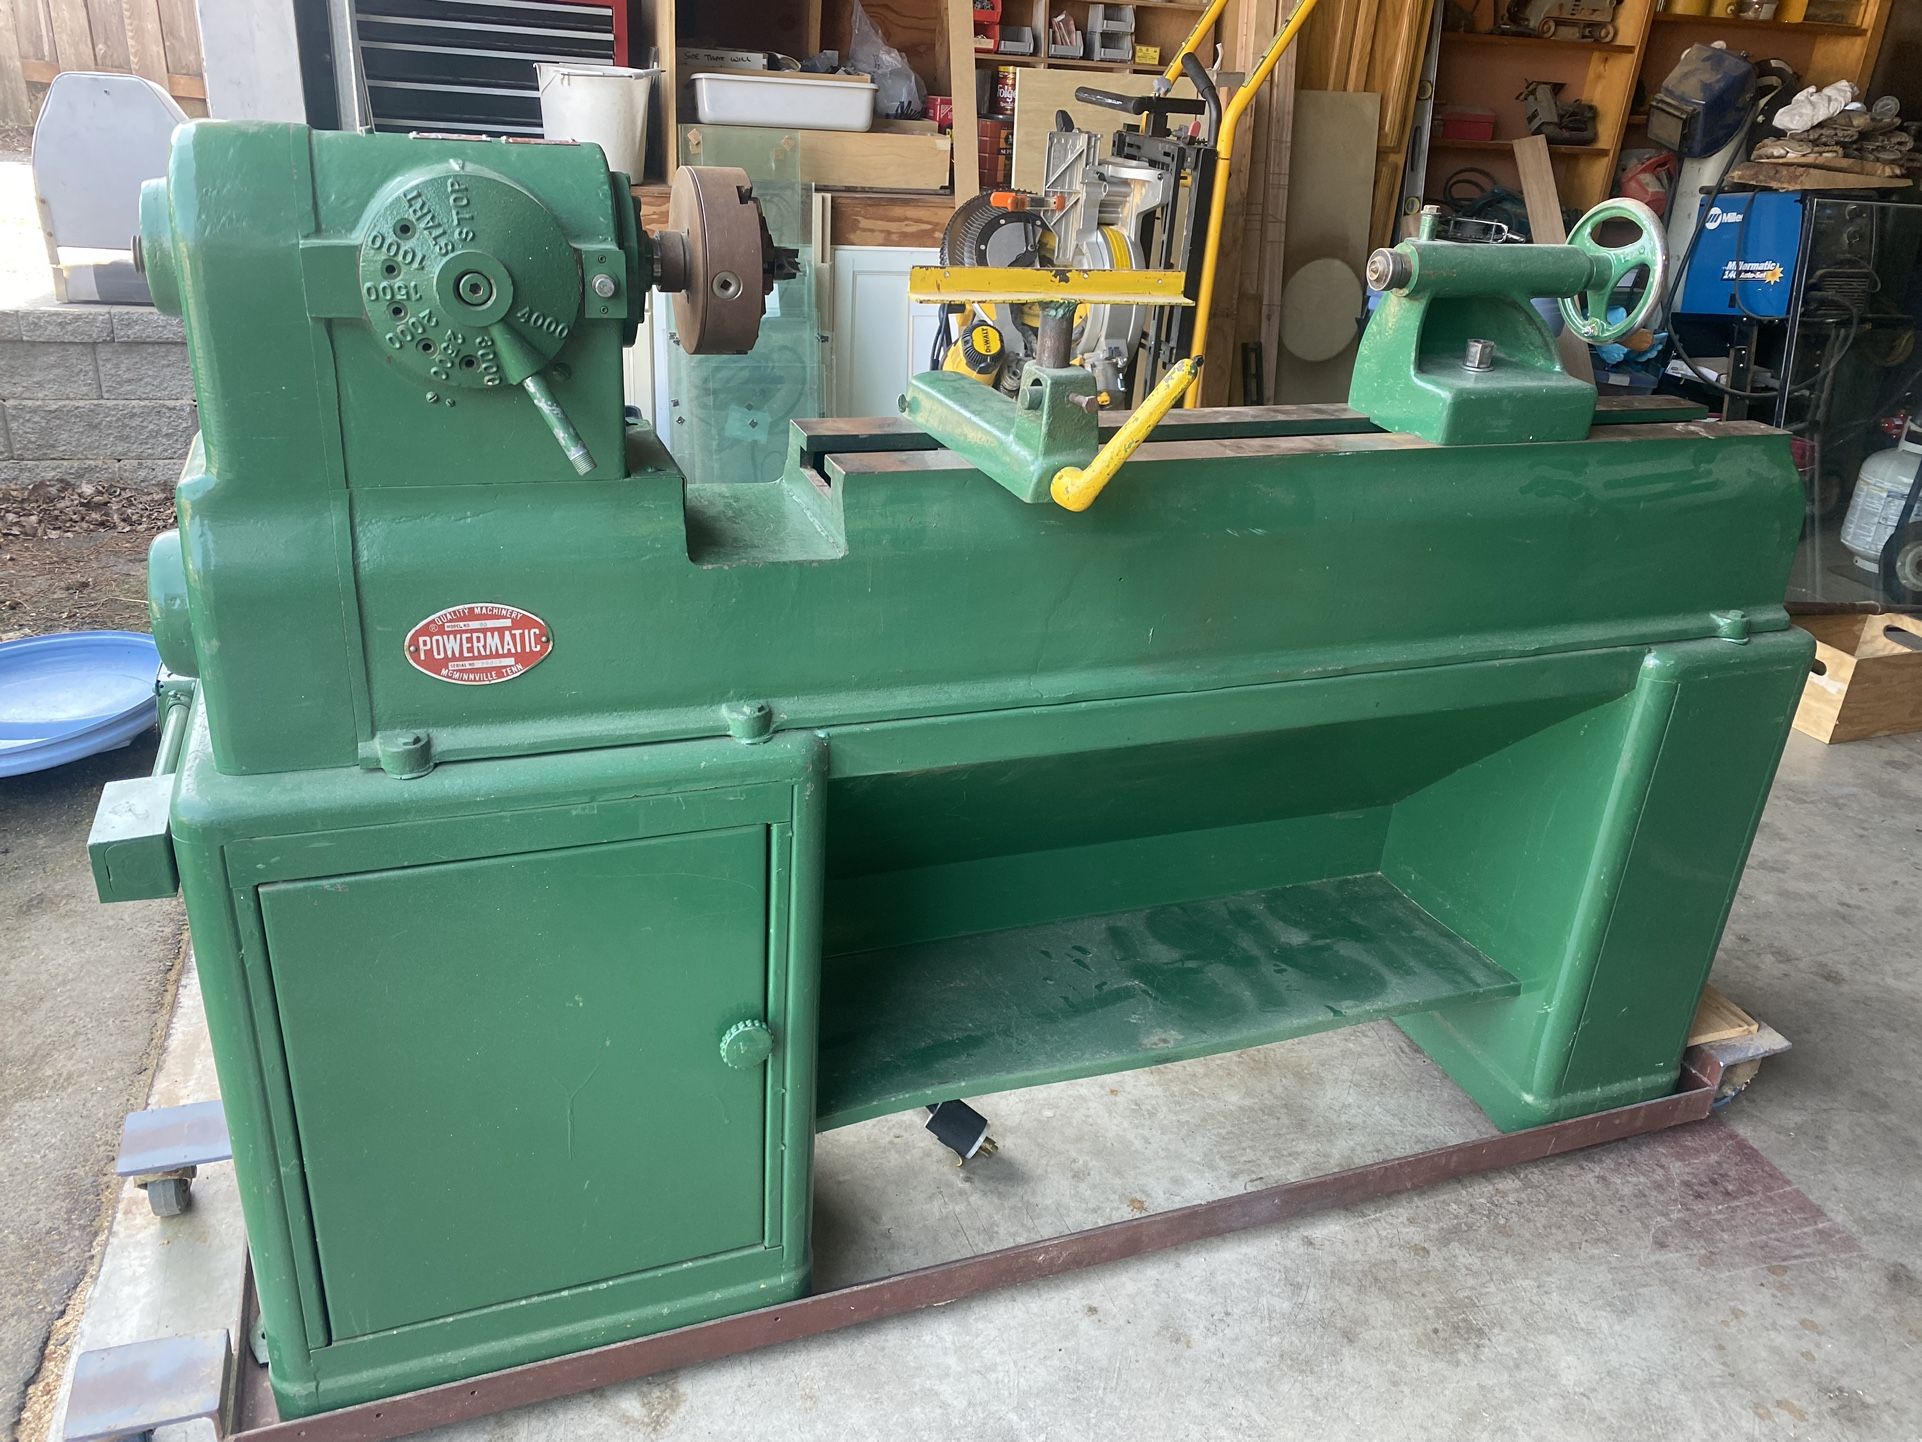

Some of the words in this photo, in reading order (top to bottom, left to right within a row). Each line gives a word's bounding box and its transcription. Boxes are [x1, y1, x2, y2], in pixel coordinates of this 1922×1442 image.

[401, 190, 455, 257] START
[447, 178, 475, 242] STOP
[369, 231, 426, 271] 1000
[364, 281, 423, 301] 1500
[385, 308, 438, 349] 2000
[516, 305, 569, 339] 4000
[430, 329, 464, 380] 2500
[475, 336, 501, 386] 3000
[434, 608, 469, 625] QUALITY
[474, 606, 523, 620] MACHINERY
[418, 628, 541, 660] POWERMATIC
